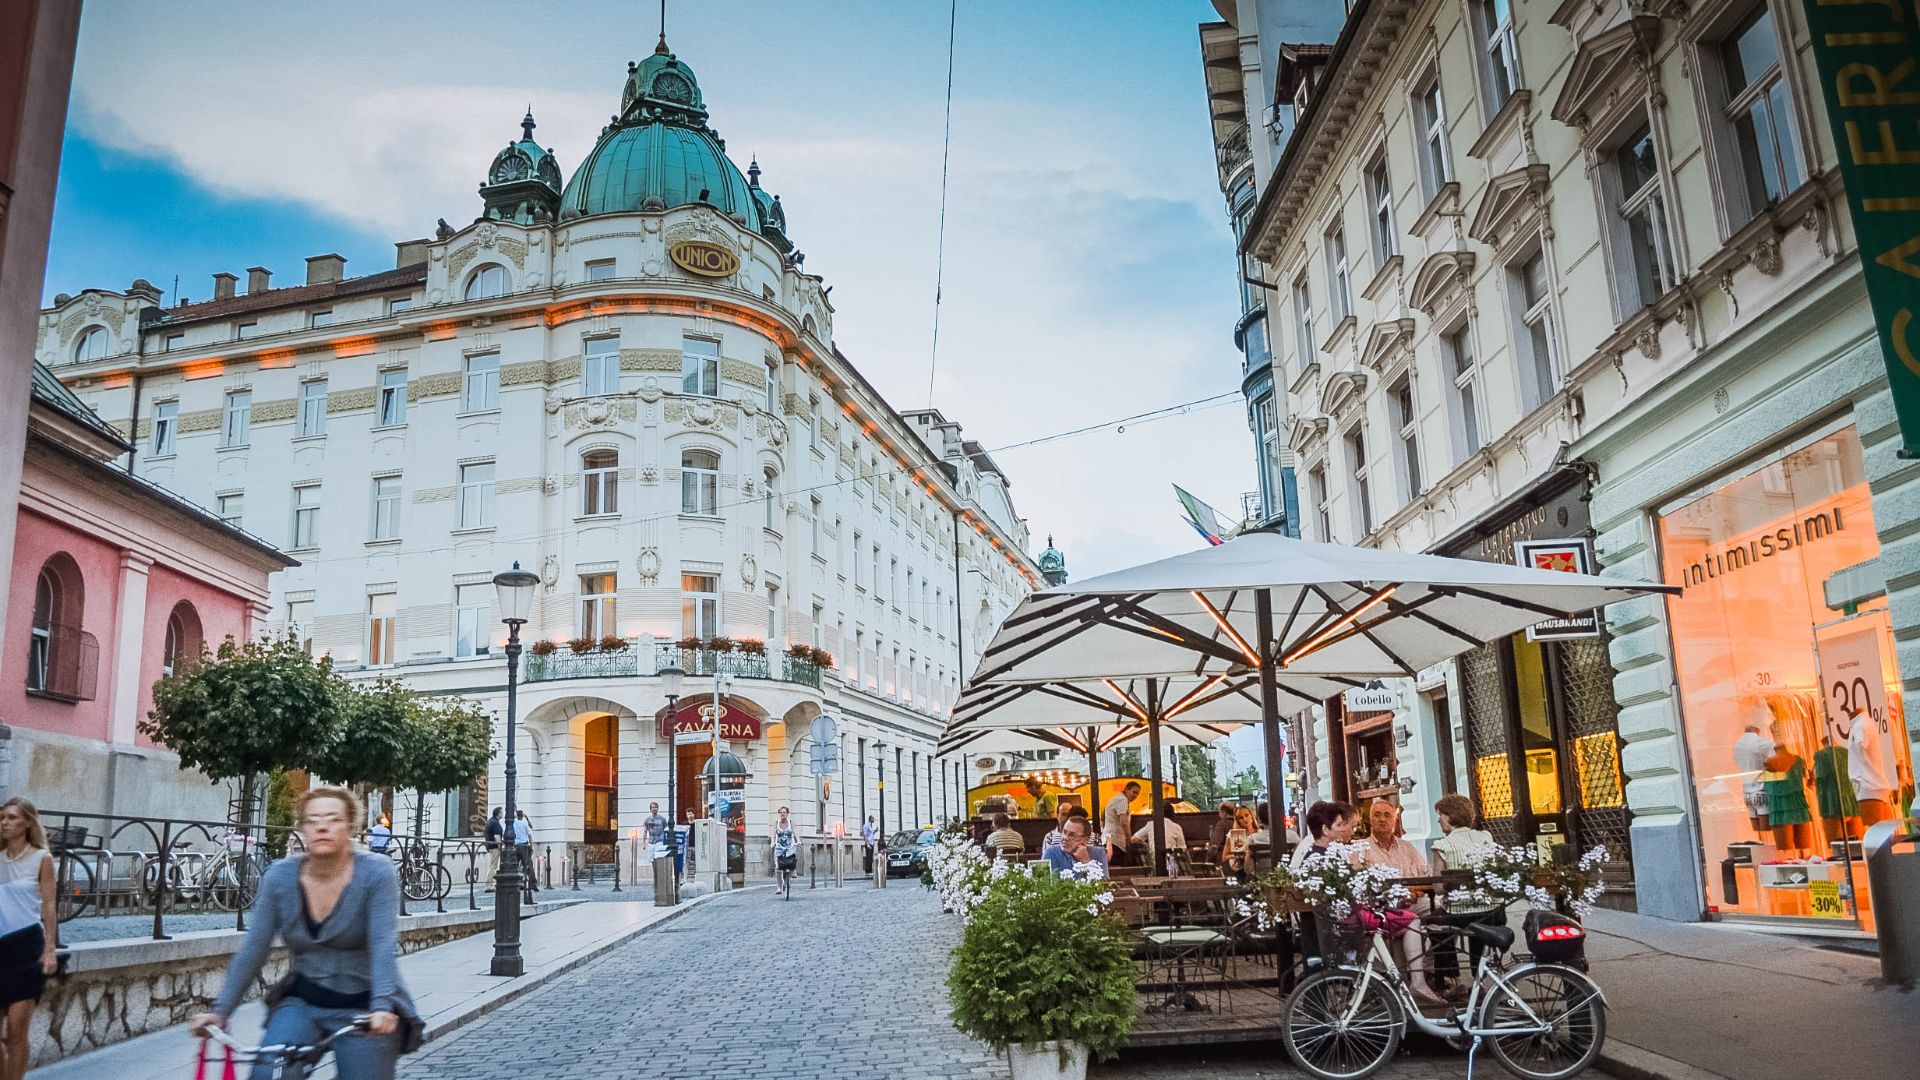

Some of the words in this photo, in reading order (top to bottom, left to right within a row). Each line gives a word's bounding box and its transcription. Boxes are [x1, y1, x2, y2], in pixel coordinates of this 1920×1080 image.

[680, 246, 732, 271] UNION
[1683, 507, 1844, 588] intimissimi
[1354, 694, 1392, 706] Cobello
[1829, 677, 1888, 740] -30%
[674, 722, 754, 737] KAVARNA
[1811, 897, 1842, 914] -30%
